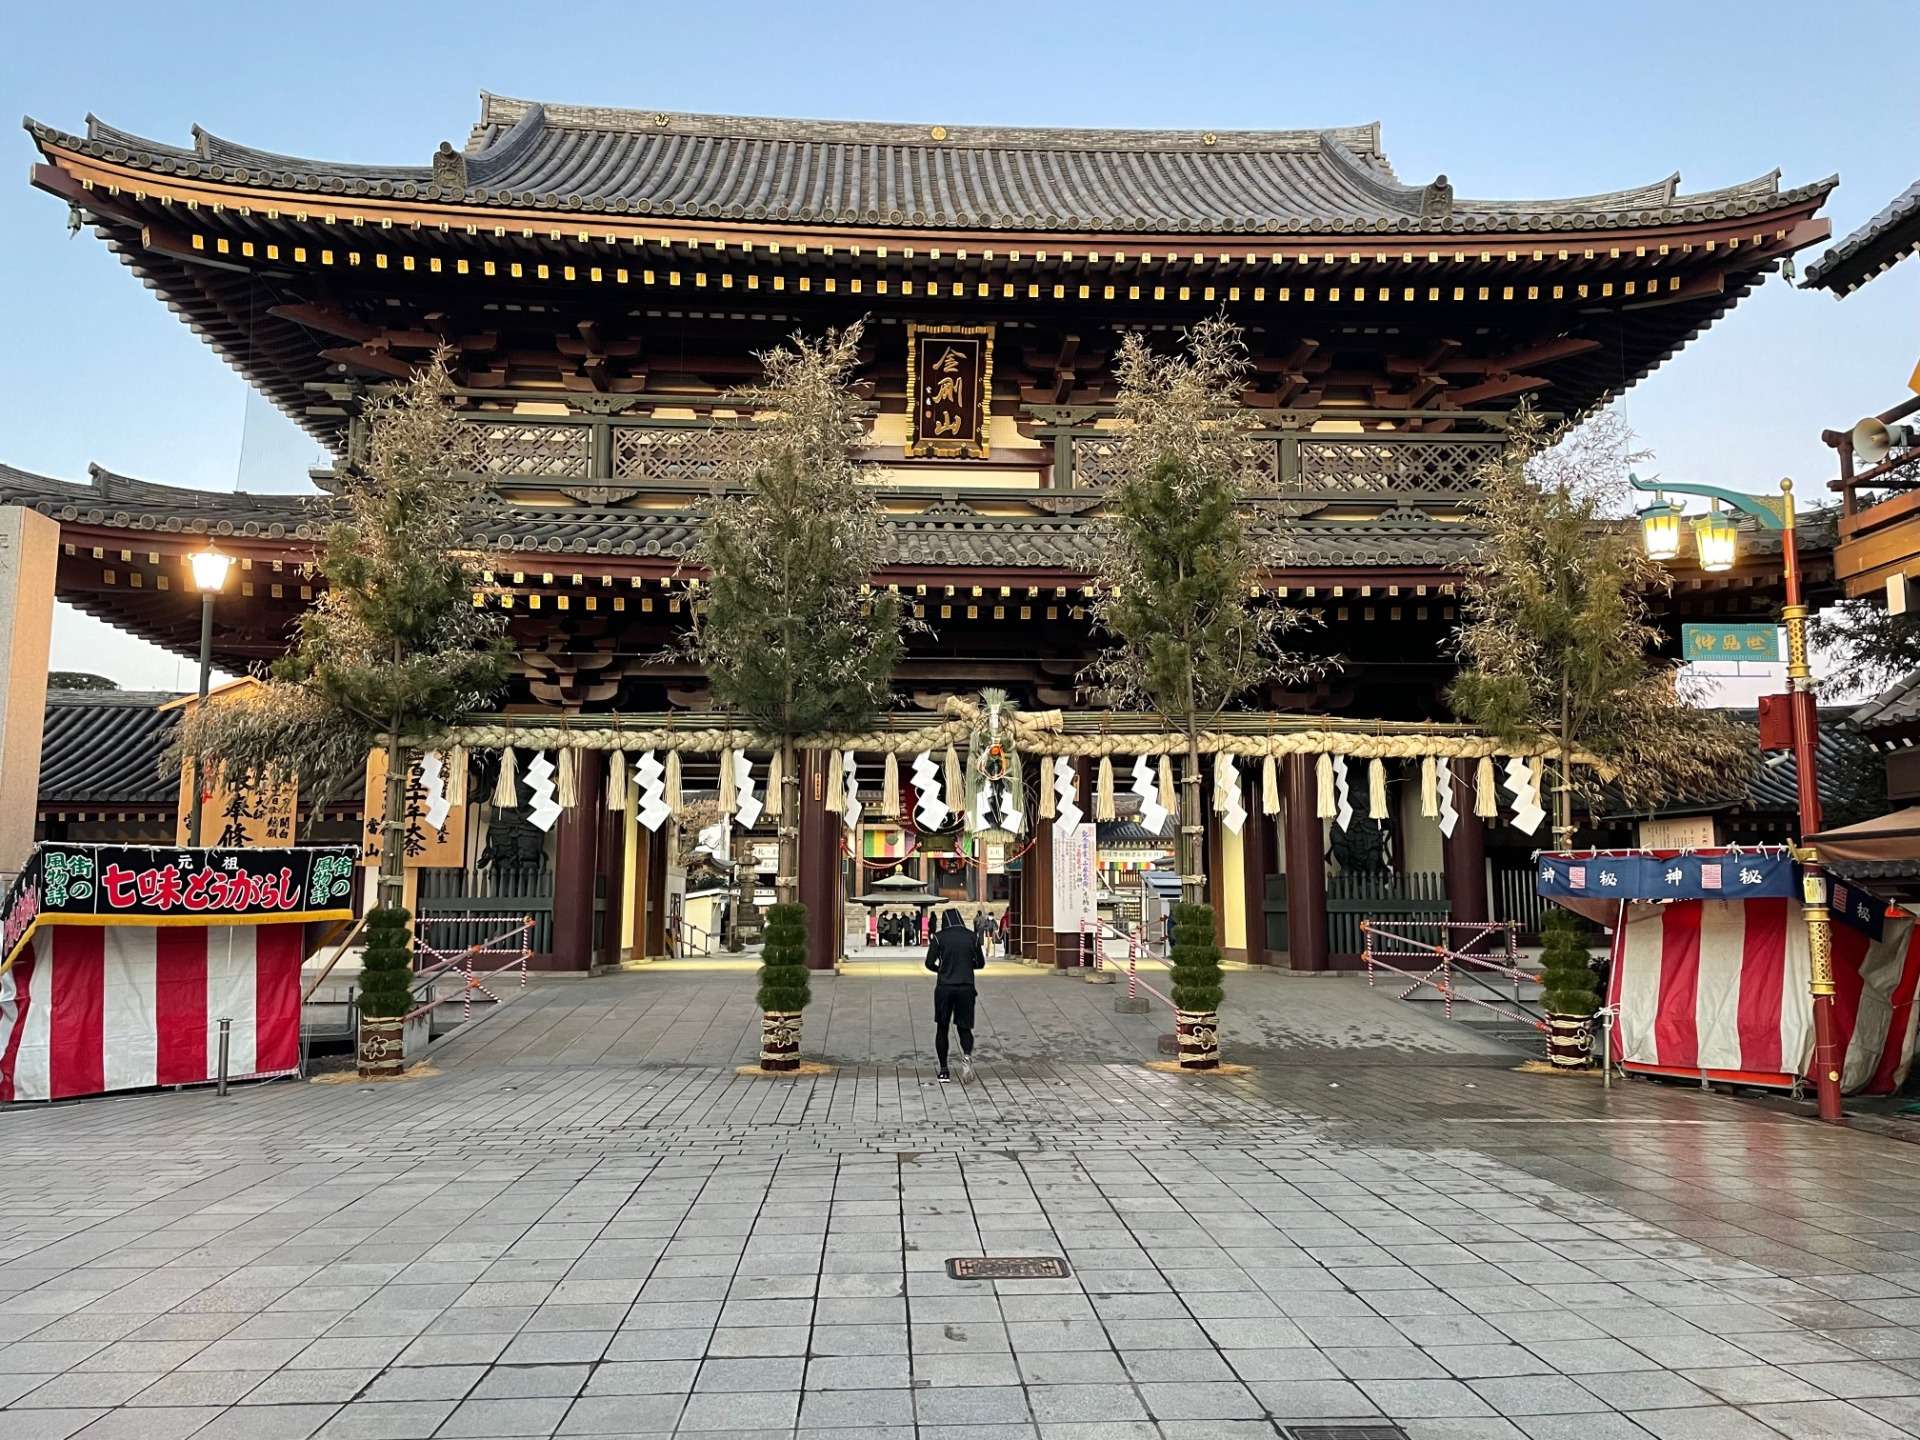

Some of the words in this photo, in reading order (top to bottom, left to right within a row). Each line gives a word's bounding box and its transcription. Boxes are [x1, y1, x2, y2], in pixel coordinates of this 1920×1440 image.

[932, 346, 967, 436] 金剛山
[1695, 633, 1766, 651] 仲見世
[404, 748, 428, 857] 百五十年大祭
[45, 853, 67, 907] 風物詩
[68, 852, 93, 899] 街の
[102, 862, 300, 910] 七味とうがらし
[178, 854, 239, 870] 元祖
[309, 855, 334, 905] 風物詩
[330, 856, 352, 897] 街の
